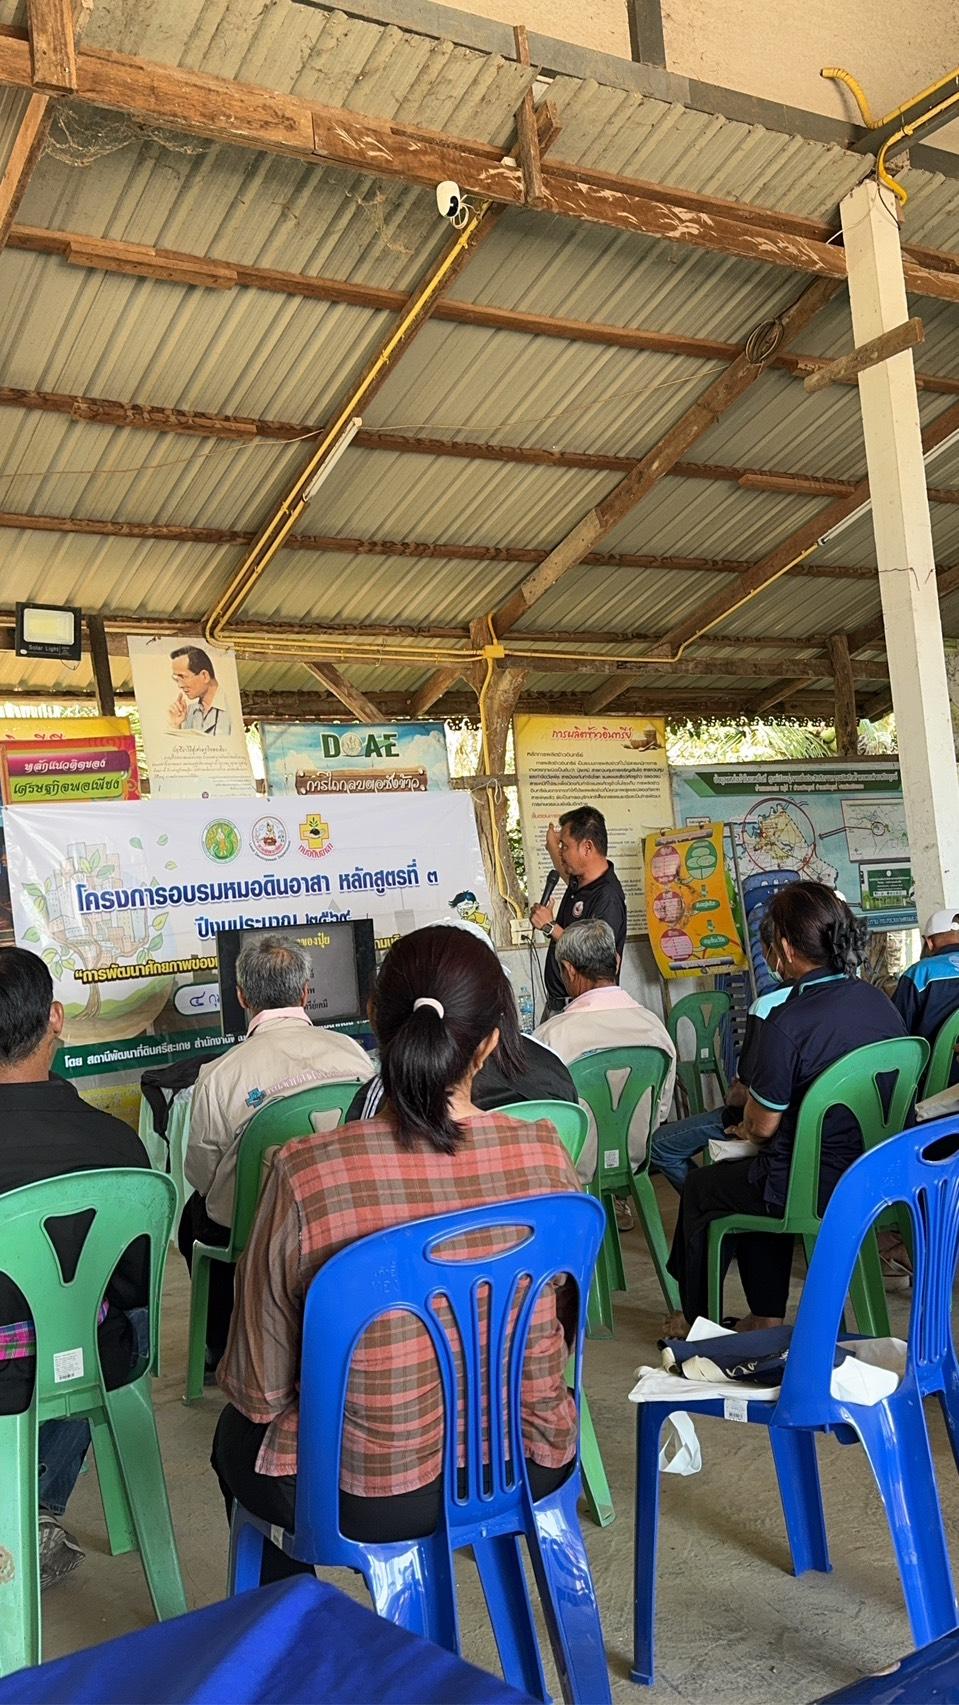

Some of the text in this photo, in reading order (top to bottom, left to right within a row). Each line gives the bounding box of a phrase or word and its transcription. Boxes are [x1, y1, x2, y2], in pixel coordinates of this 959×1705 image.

[14, 776, 120, 797] เศรษฐกิจพอเพียง
[76, 859, 438, 912] โครงการอบรมหมอดินอาสา หลักสูตรที่ ๓
[64, 1055, 83, 1068] โดย
[87, 1041, 191, 1065] สถานีพัฒนาที่ดินศรีสะเกษ
